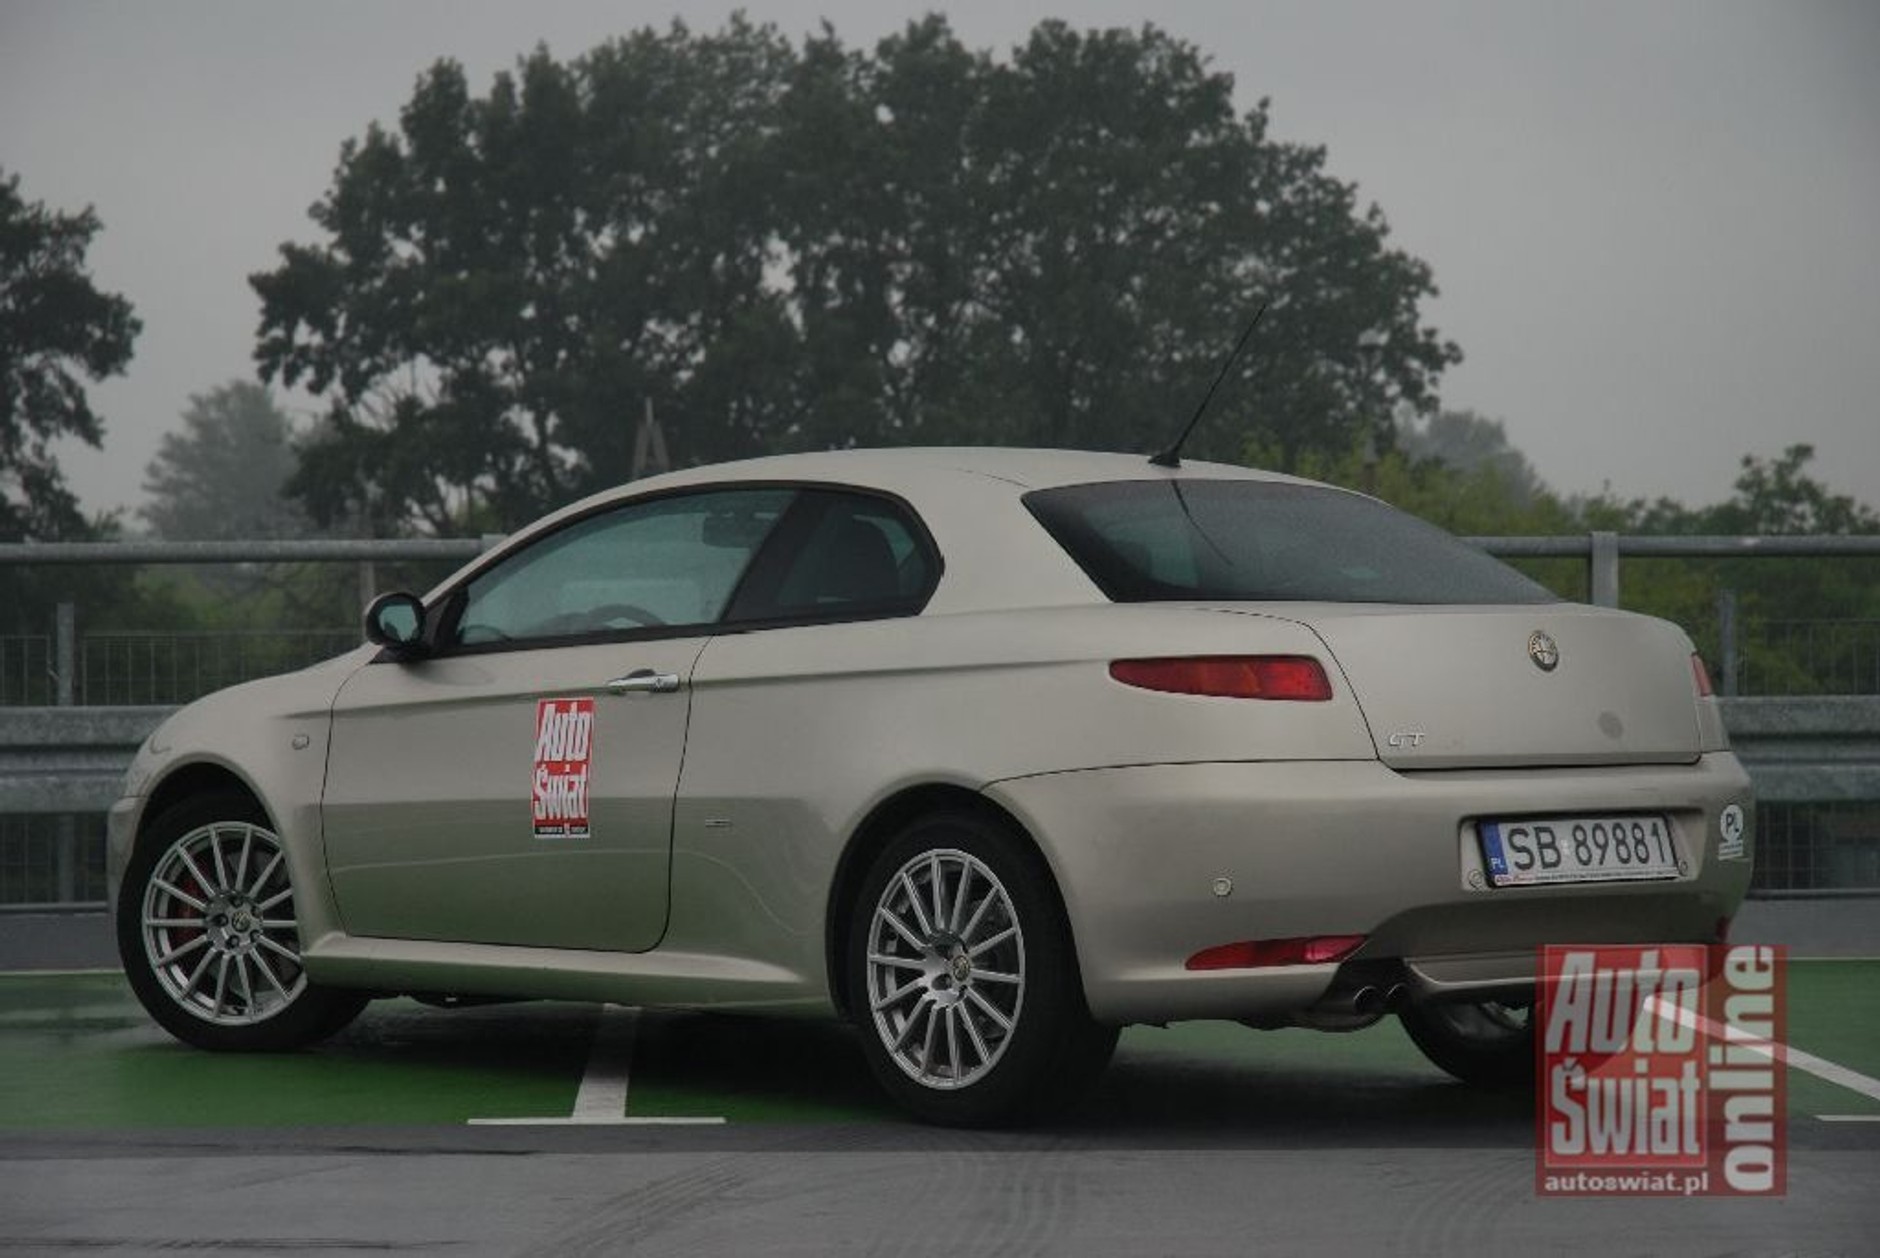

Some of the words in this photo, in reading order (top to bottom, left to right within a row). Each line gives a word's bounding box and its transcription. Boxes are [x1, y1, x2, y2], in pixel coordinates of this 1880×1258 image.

[534, 702, 591, 762] Auto
[1507, 826, 1562, 870] SB
[1571, 822, 1666, 866] 89881
